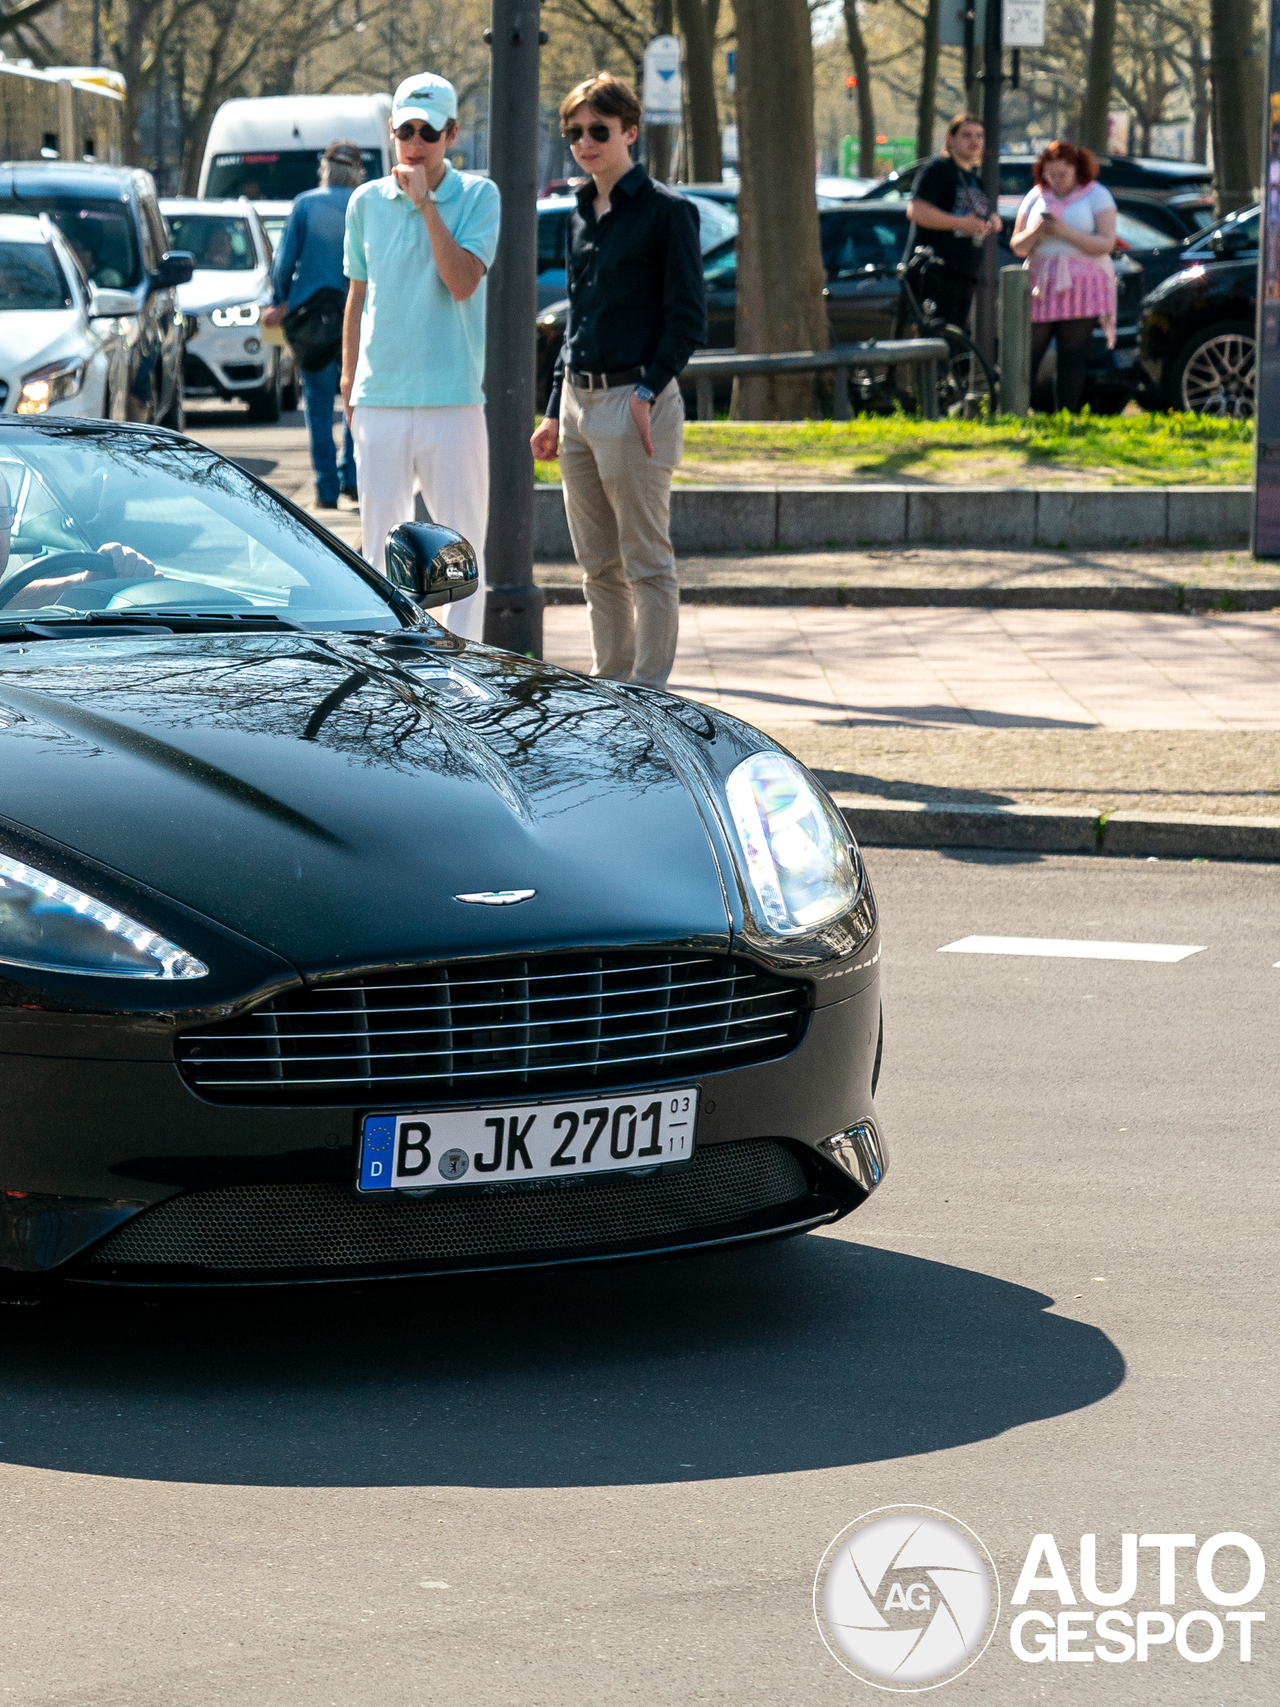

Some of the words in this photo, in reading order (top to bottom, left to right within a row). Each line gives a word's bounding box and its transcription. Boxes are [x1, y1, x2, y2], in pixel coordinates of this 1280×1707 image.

[670, 1097, 690, 1113] 03
[396, 1120, 432, 1177] B
[474, 1113, 537, 1173] JK
[550, 1101, 664, 1167] 2701
[669, 1136, 685, 1152] 11
[370, 1161, 383, 1177] D
[482, 1183, 516, 1195] ASTON
